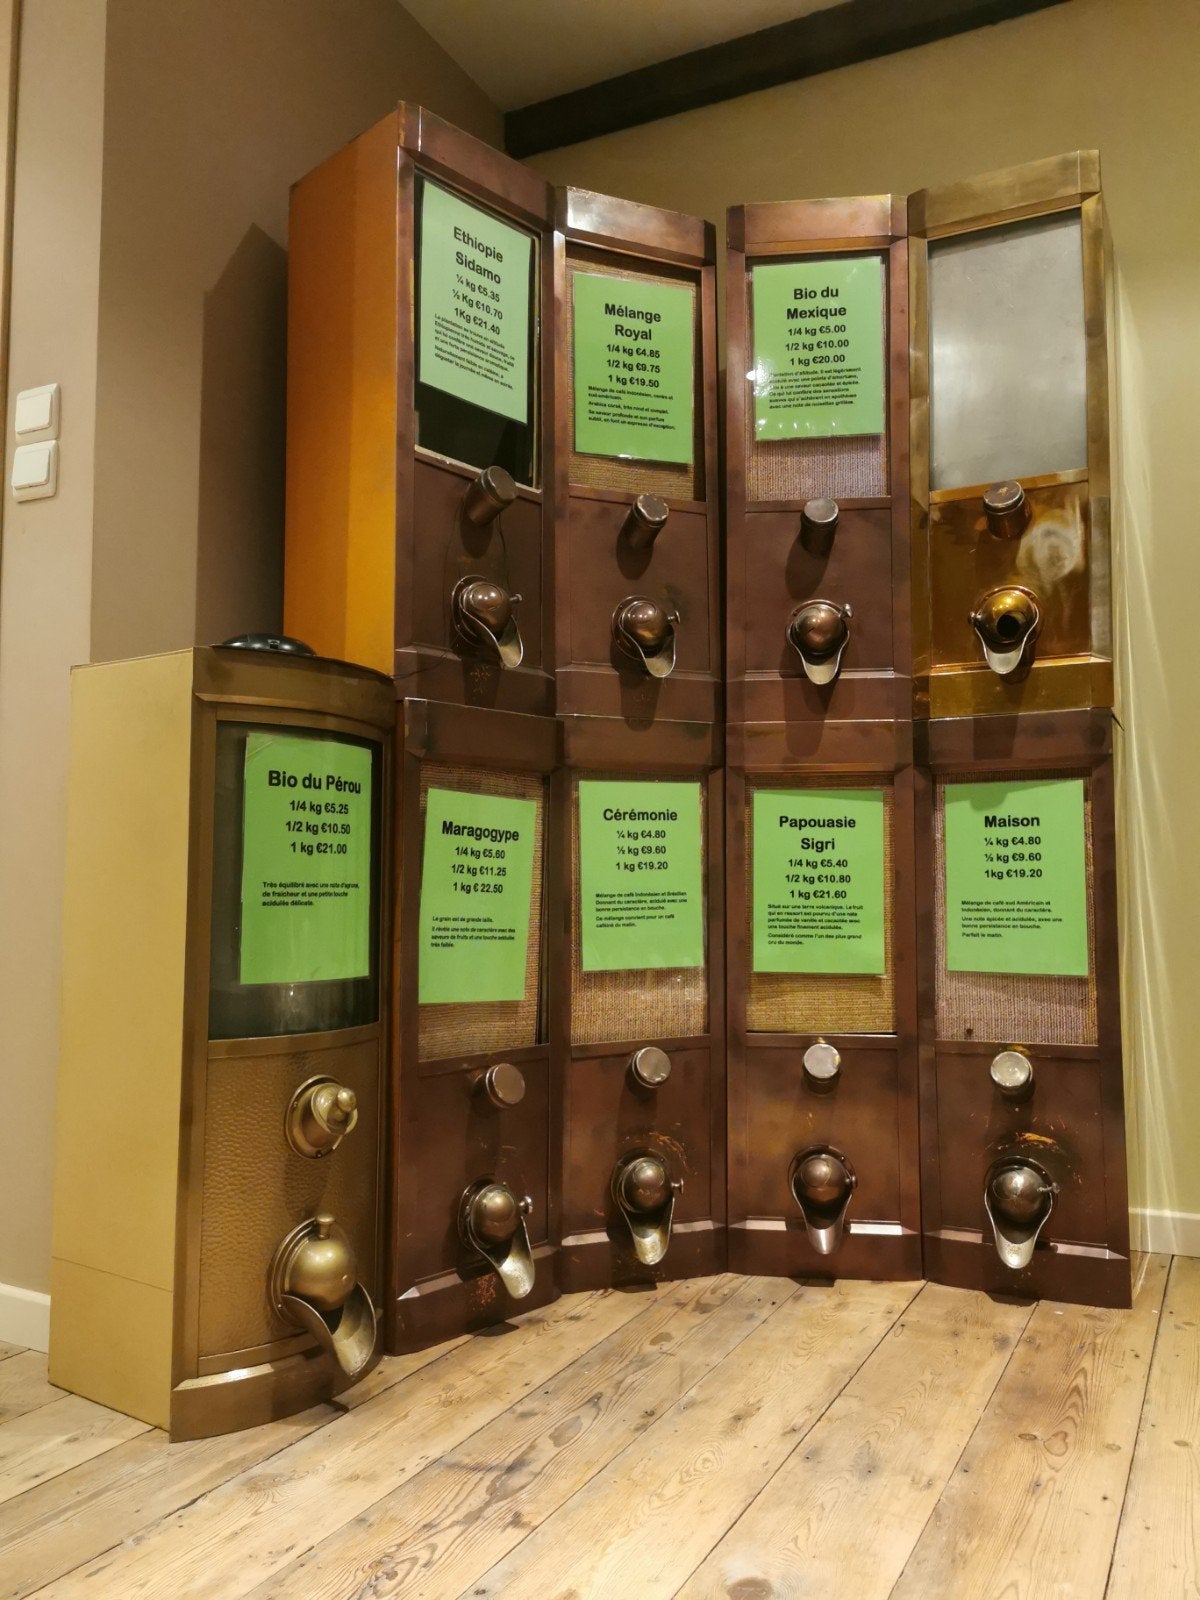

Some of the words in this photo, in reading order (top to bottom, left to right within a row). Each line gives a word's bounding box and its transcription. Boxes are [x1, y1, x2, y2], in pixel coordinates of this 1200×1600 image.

[453, 225, 503, 263] Ethiopie
[455, 251, 501, 284] Sidamo
[465, 278, 476, 293] kg
[477, 284, 500, 303] €5.35
[793, 288, 817, 300] Bio
[820, 286, 839, 298] du
[461, 293, 474, 308] Kg
[475, 300, 503, 320] €10.70
[604, 303, 661, 324] Mélange
[786, 306, 847, 320] Mexique
[473, 315, 500, 335] €21.40
[788, 328, 802, 336] 1/4
[805, 327, 817, 336] kg
[819, 325, 846, 334] €5.00
[614, 324, 652, 341] Royal
[606, 344, 620, 353] 1/4
[622, 346, 634, 357] kg
[635, 347, 660, 359] €4.85
[785, 343, 800, 351] 1/2
[802, 342, 814, 351] kg
[816, 339, 849, 349] €10.00
[606, 359, 620, 368] 1/2
[622, 361, 634, 372] kg
[635, 362, 661, 373] €9.75
[790, 358, 795, 366] 1
[798, 357, 810, 367] kg
[812, 354, 845, 364] €20.00
[608, 374, 613, 382] 1
[616, 375, 627, 386] kg
[629, 377, 660, 388] €19.50
[268, 770, 298, 788] Bio
[302, 773, 322, 789] du
[326, 774, 361, 794] Pérou
[289, 800, 307, 811] 1/4
[309, 801, 322, 815] kg
[324, 803, 349, 815] €5.25
[603, 808, 678, 821] Cérémonie
[285, 821, 303, 832] 1/2
[306, 821, 319, 835] kg
[321, 822, 351, 835] €10.50
[779, 815, 856, 831] Papouasie
[984, 815, 1040, 828] Maison
[442, 820, 519, 843] Maragogype
[627, 830, 639, 840] kg
[641, 830, 666, 839] €4.80
[290, 841, 296, 853] 1
[300, 842, 314, 856] kg
[316, 842, 347, 854] €21.00
[800, 837, 835, 853] Sigri
[996, 837, 1009, 848] kg
[1011, 836, 1041, 845] €4.80
[455, 846, 468, 856] 1/4
[470, 847, 481, 859] kg
[482, 848, 505, 859] €5.60
[627, 845, 639, 856] kg
[641, 845, 666, 854] €9.60
[788, 859, 803, 868] 1/4
[805, 859, 818, 869] kg
[820, 859, 848, 868] €5.40
[996, 853, 1009, 864] kg
[1011, 852, 1042, 862] €9.60
[451, 864, 465, 874] 1/2
[466, 865, 477, 877] kg
[479, 866, 507, 877] €11.25
[616, 862, 620, 870] 1
[623, 862, 635, 872] kg
[637, 861, 668, 870] €19.20
[785, 874, 800, 883] 1/2
[802, 874, 815, 885] kg
[817, 874, 851, 884] €10.80
[984, 869, 1004, 880] 1kg
[1006, 868, 1043, 878] €19.20
[453, 882, 458, 891] 1
[460, 882, 471, 894] kg
[480, 883, 503, 894] 22.50
[790, 890, 794, 898] 1
[798, 890, 811, 900] kg
[813, 890, 847, 899] €21.60
